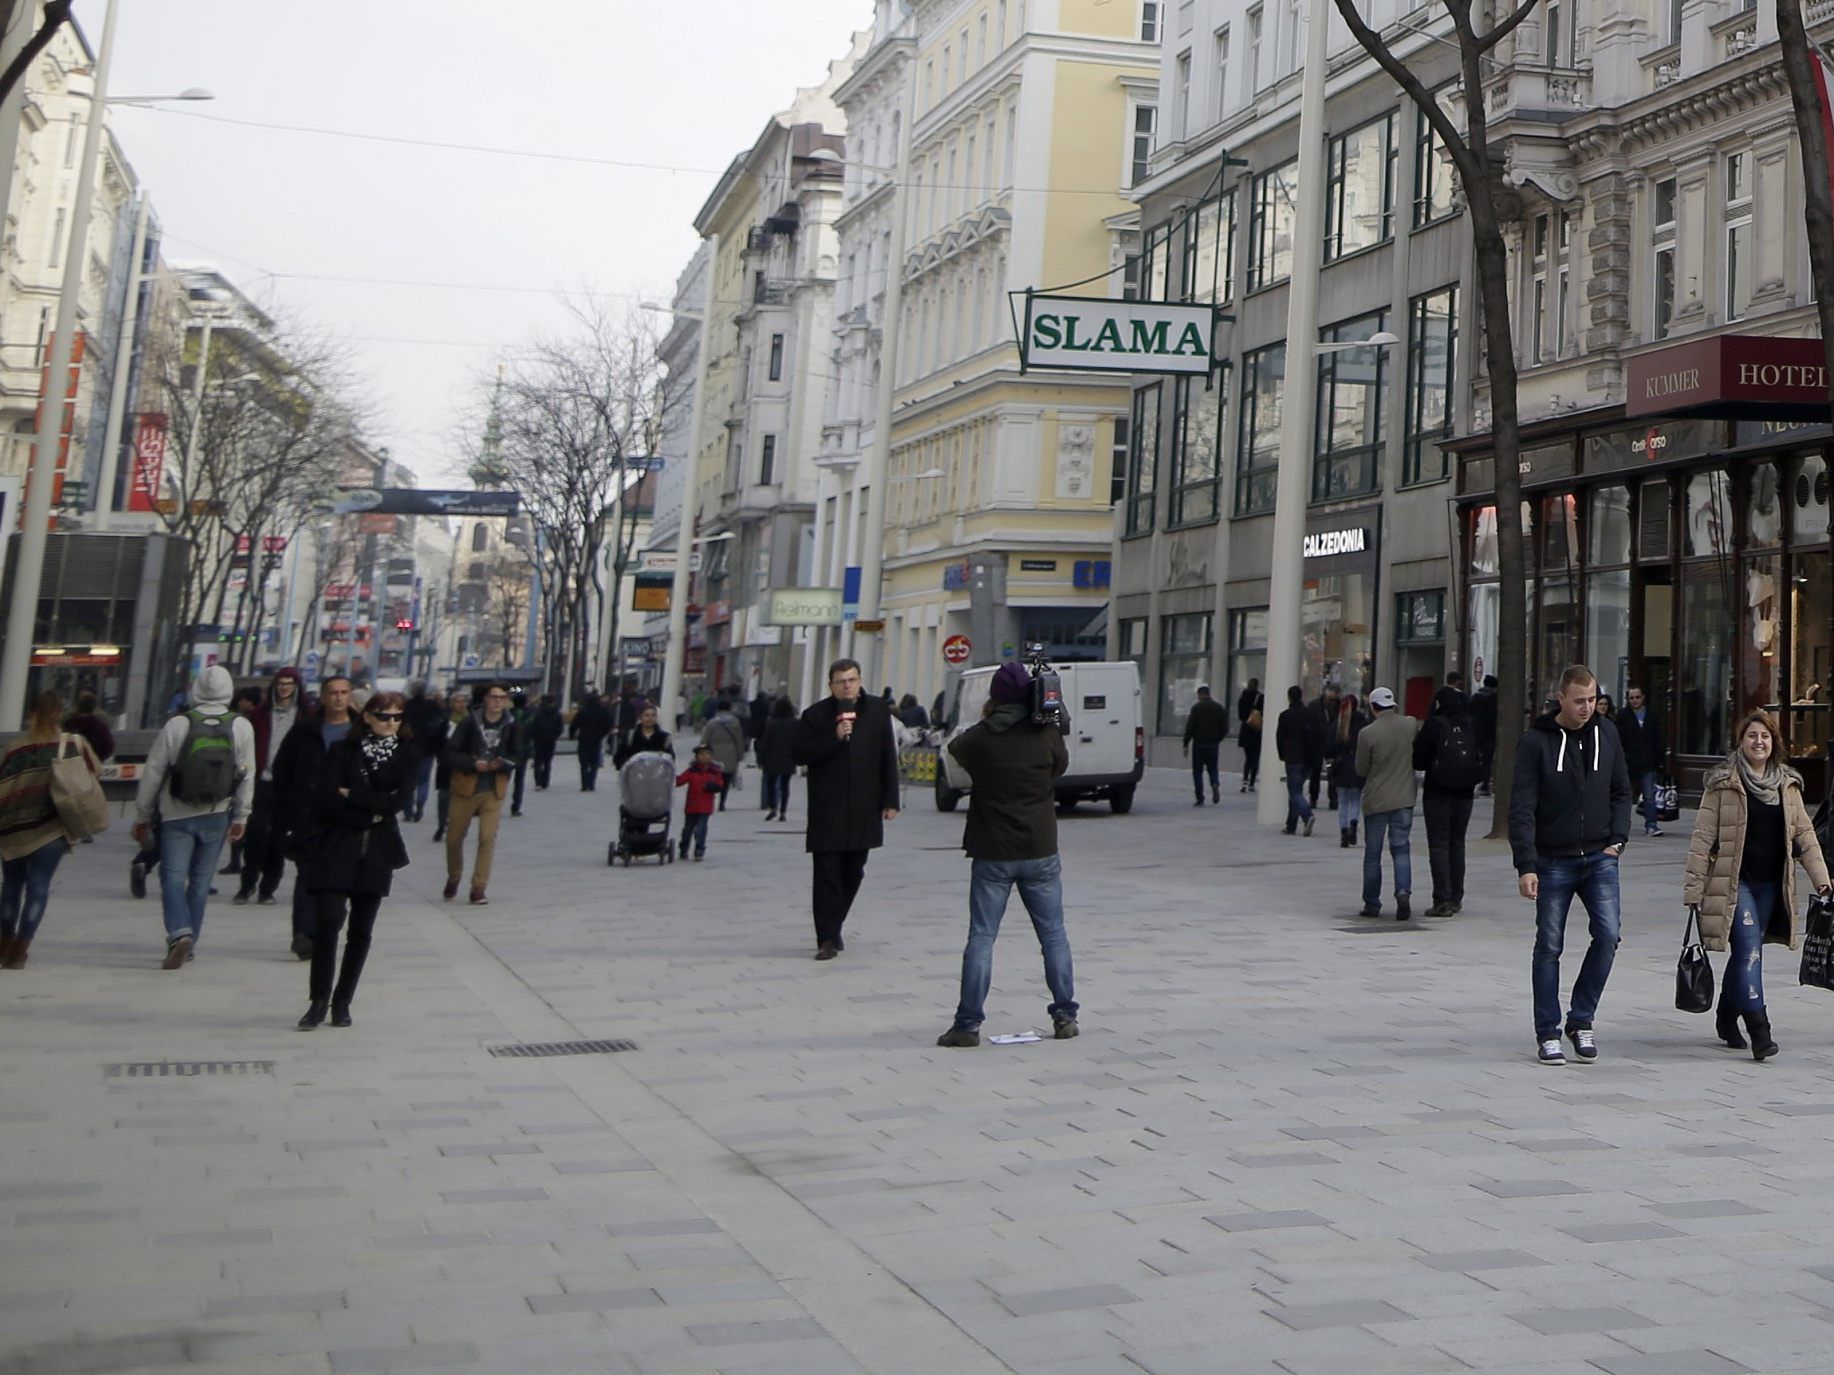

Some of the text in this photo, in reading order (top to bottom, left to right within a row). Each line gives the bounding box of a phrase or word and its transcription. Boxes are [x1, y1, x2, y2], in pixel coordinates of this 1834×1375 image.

[1033, 314, 1209, 356] SLAMA
[1646, 368, 1700, 400] KUMMER
[1739, 363, 1831, 387] HOTEL
[1303, 528, 1365, 558] CALZEDONIA
